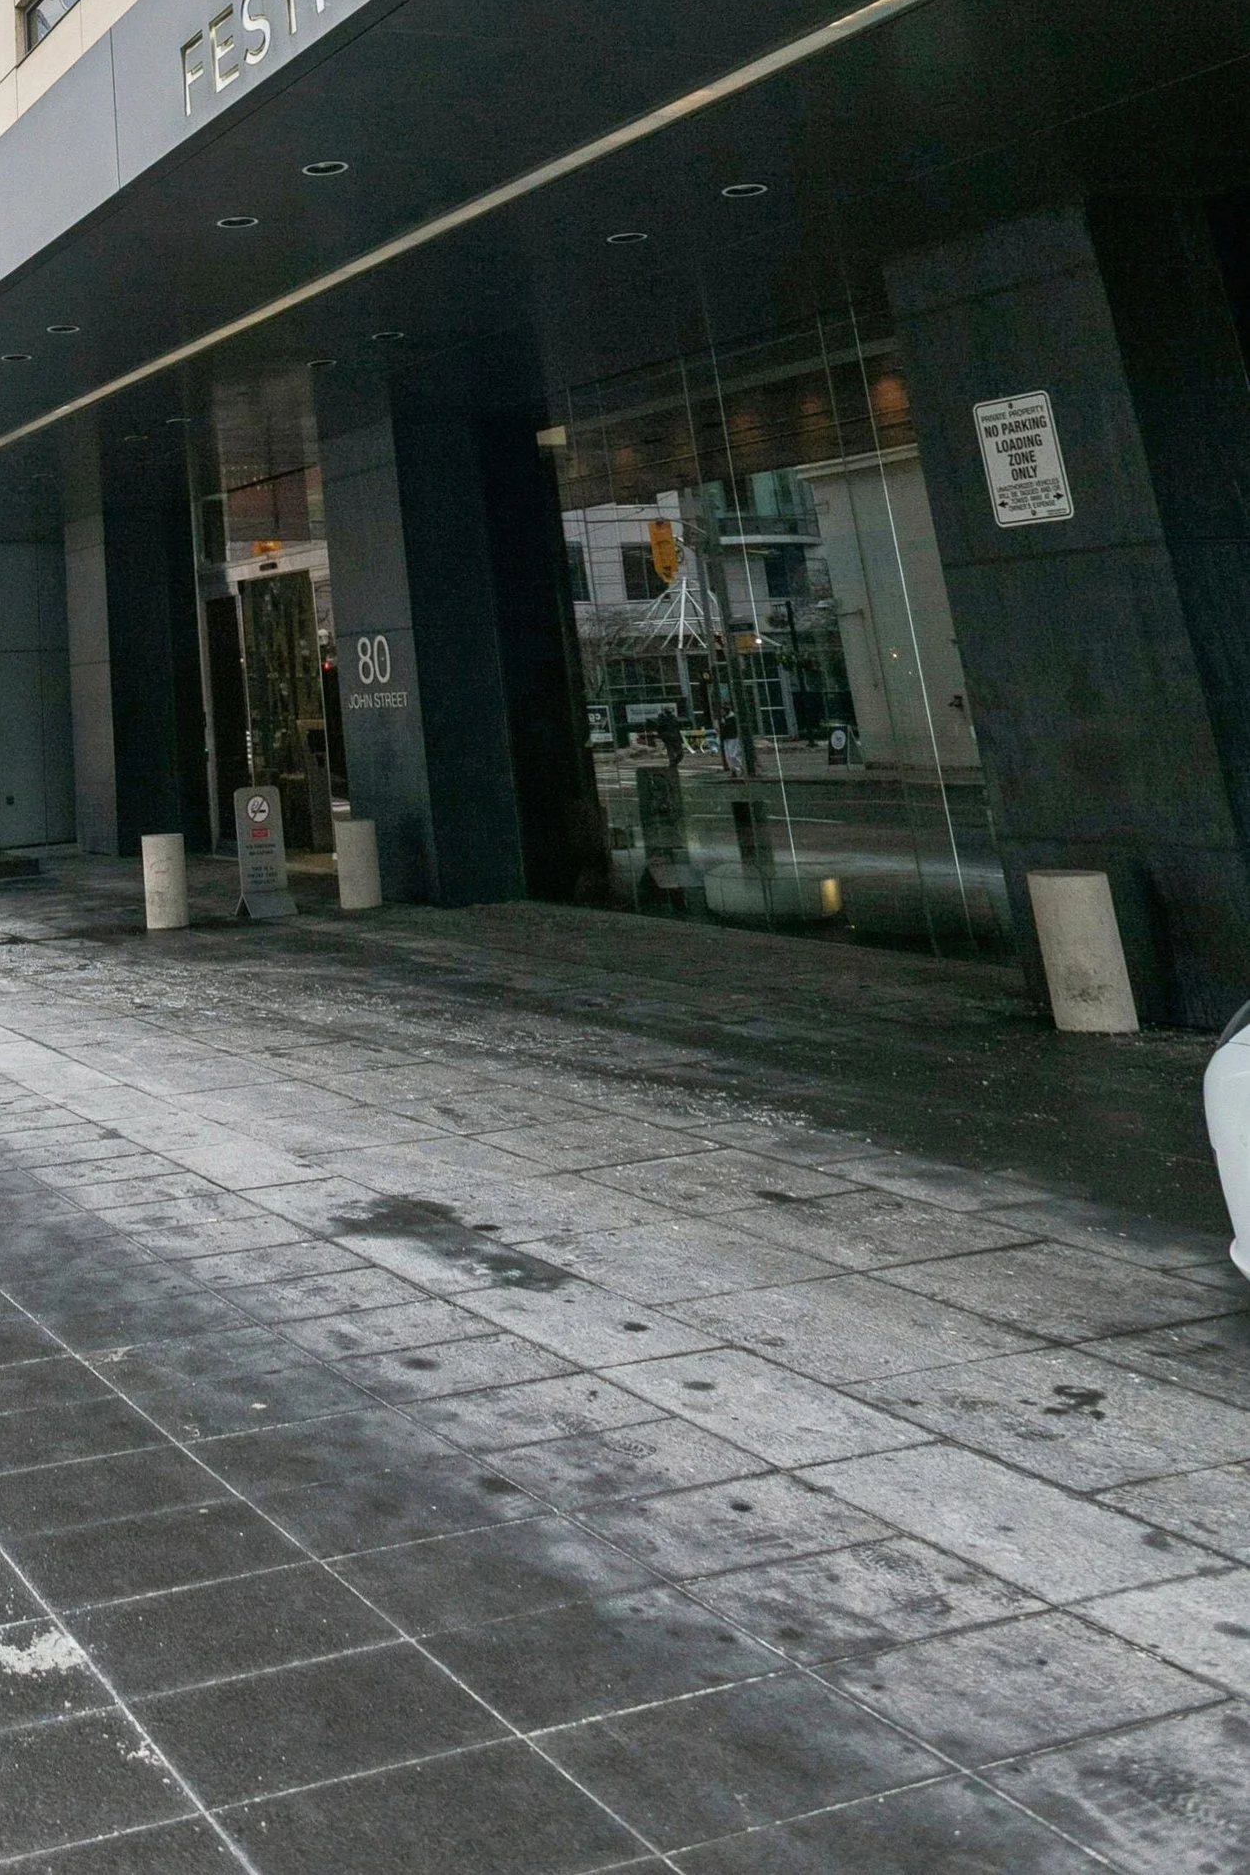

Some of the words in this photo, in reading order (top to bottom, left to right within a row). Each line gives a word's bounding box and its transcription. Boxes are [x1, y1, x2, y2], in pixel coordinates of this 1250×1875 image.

[981, 412, 1007, 423] PRIVATE
[1008, 405, 1044, 418] PROPERTY
[984, 425, 999, 439] NO
[1001, 416, 1047, 436] PARKING
[995, 434, 1043, 454] LOADING
[1007, 450, 1037, 467] ZONE
[1011, 465, 1038, 482] ONLY
[357, 634, 391, 684] 80
[348, 692, 373, 709] JOHN
[373, 691, 409, 709] STREET
